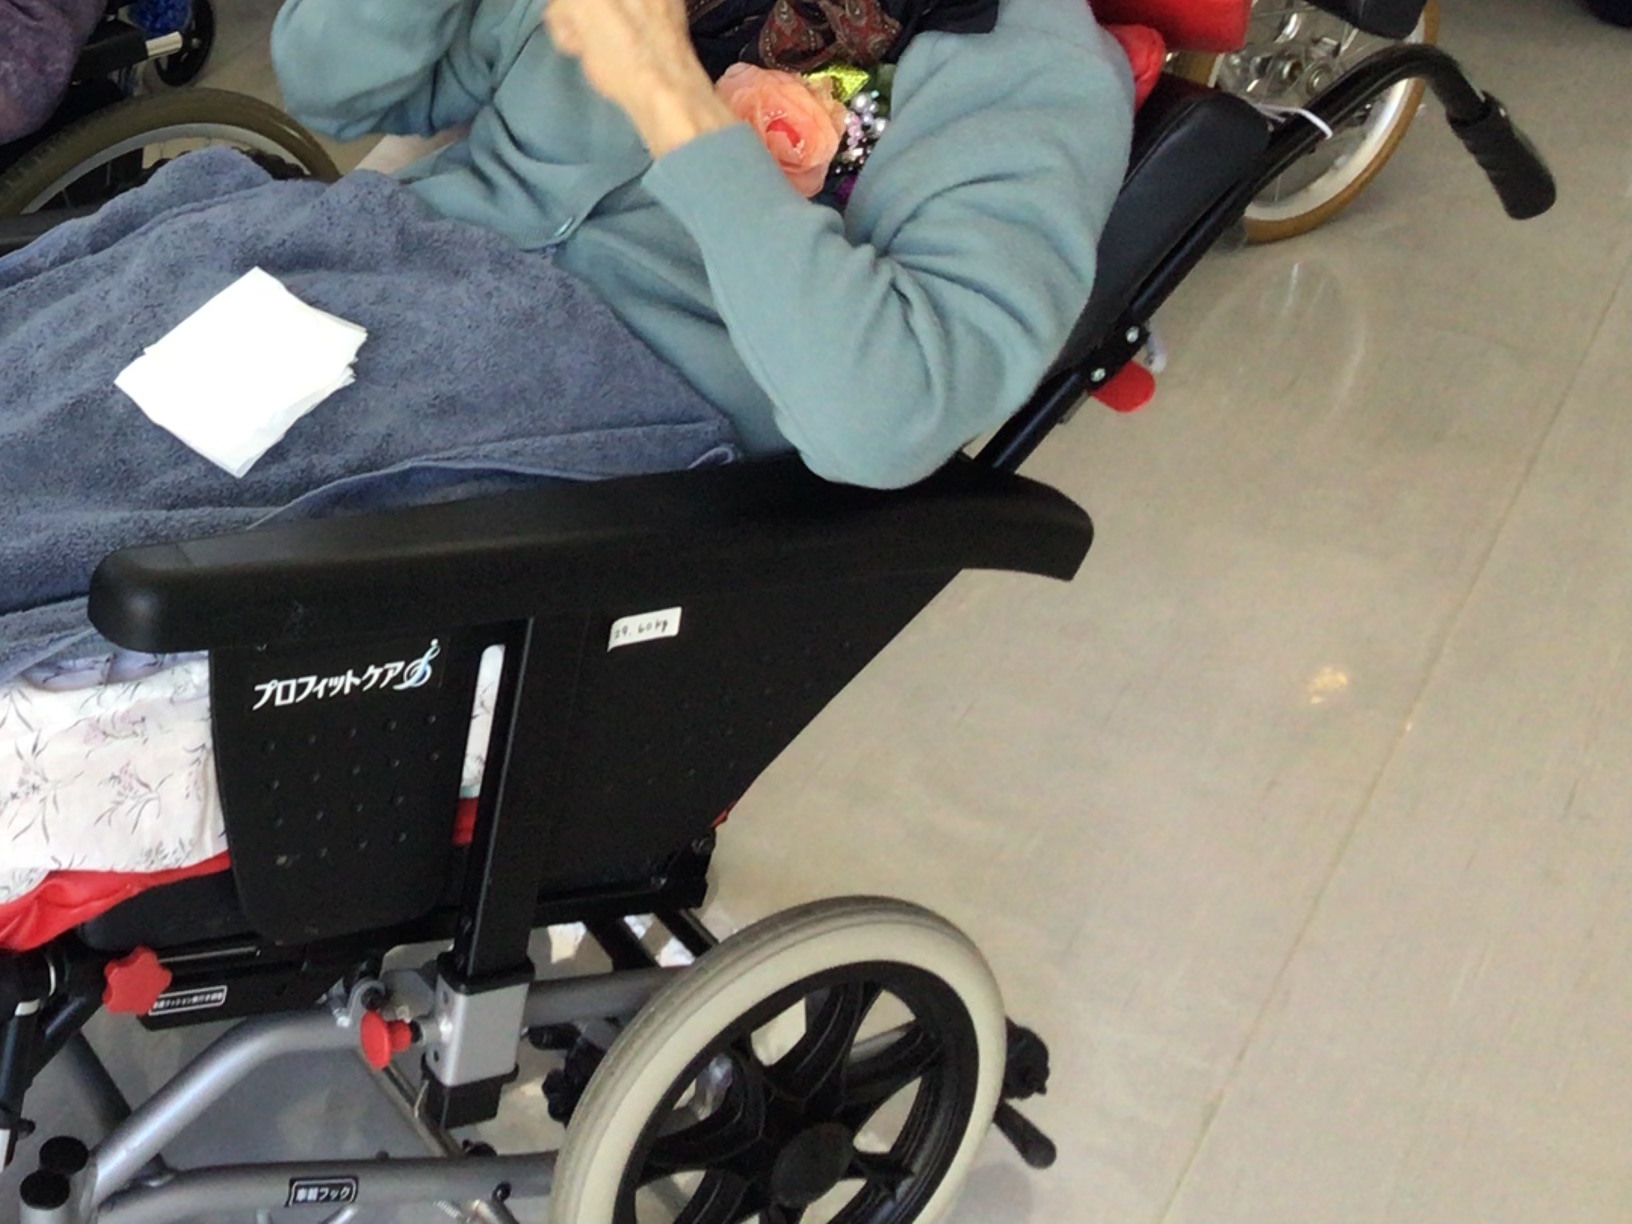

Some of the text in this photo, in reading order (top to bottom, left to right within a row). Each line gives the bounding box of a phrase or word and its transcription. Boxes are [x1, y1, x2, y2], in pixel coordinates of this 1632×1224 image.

[252, 661, 406, 711] プロフィットケア
